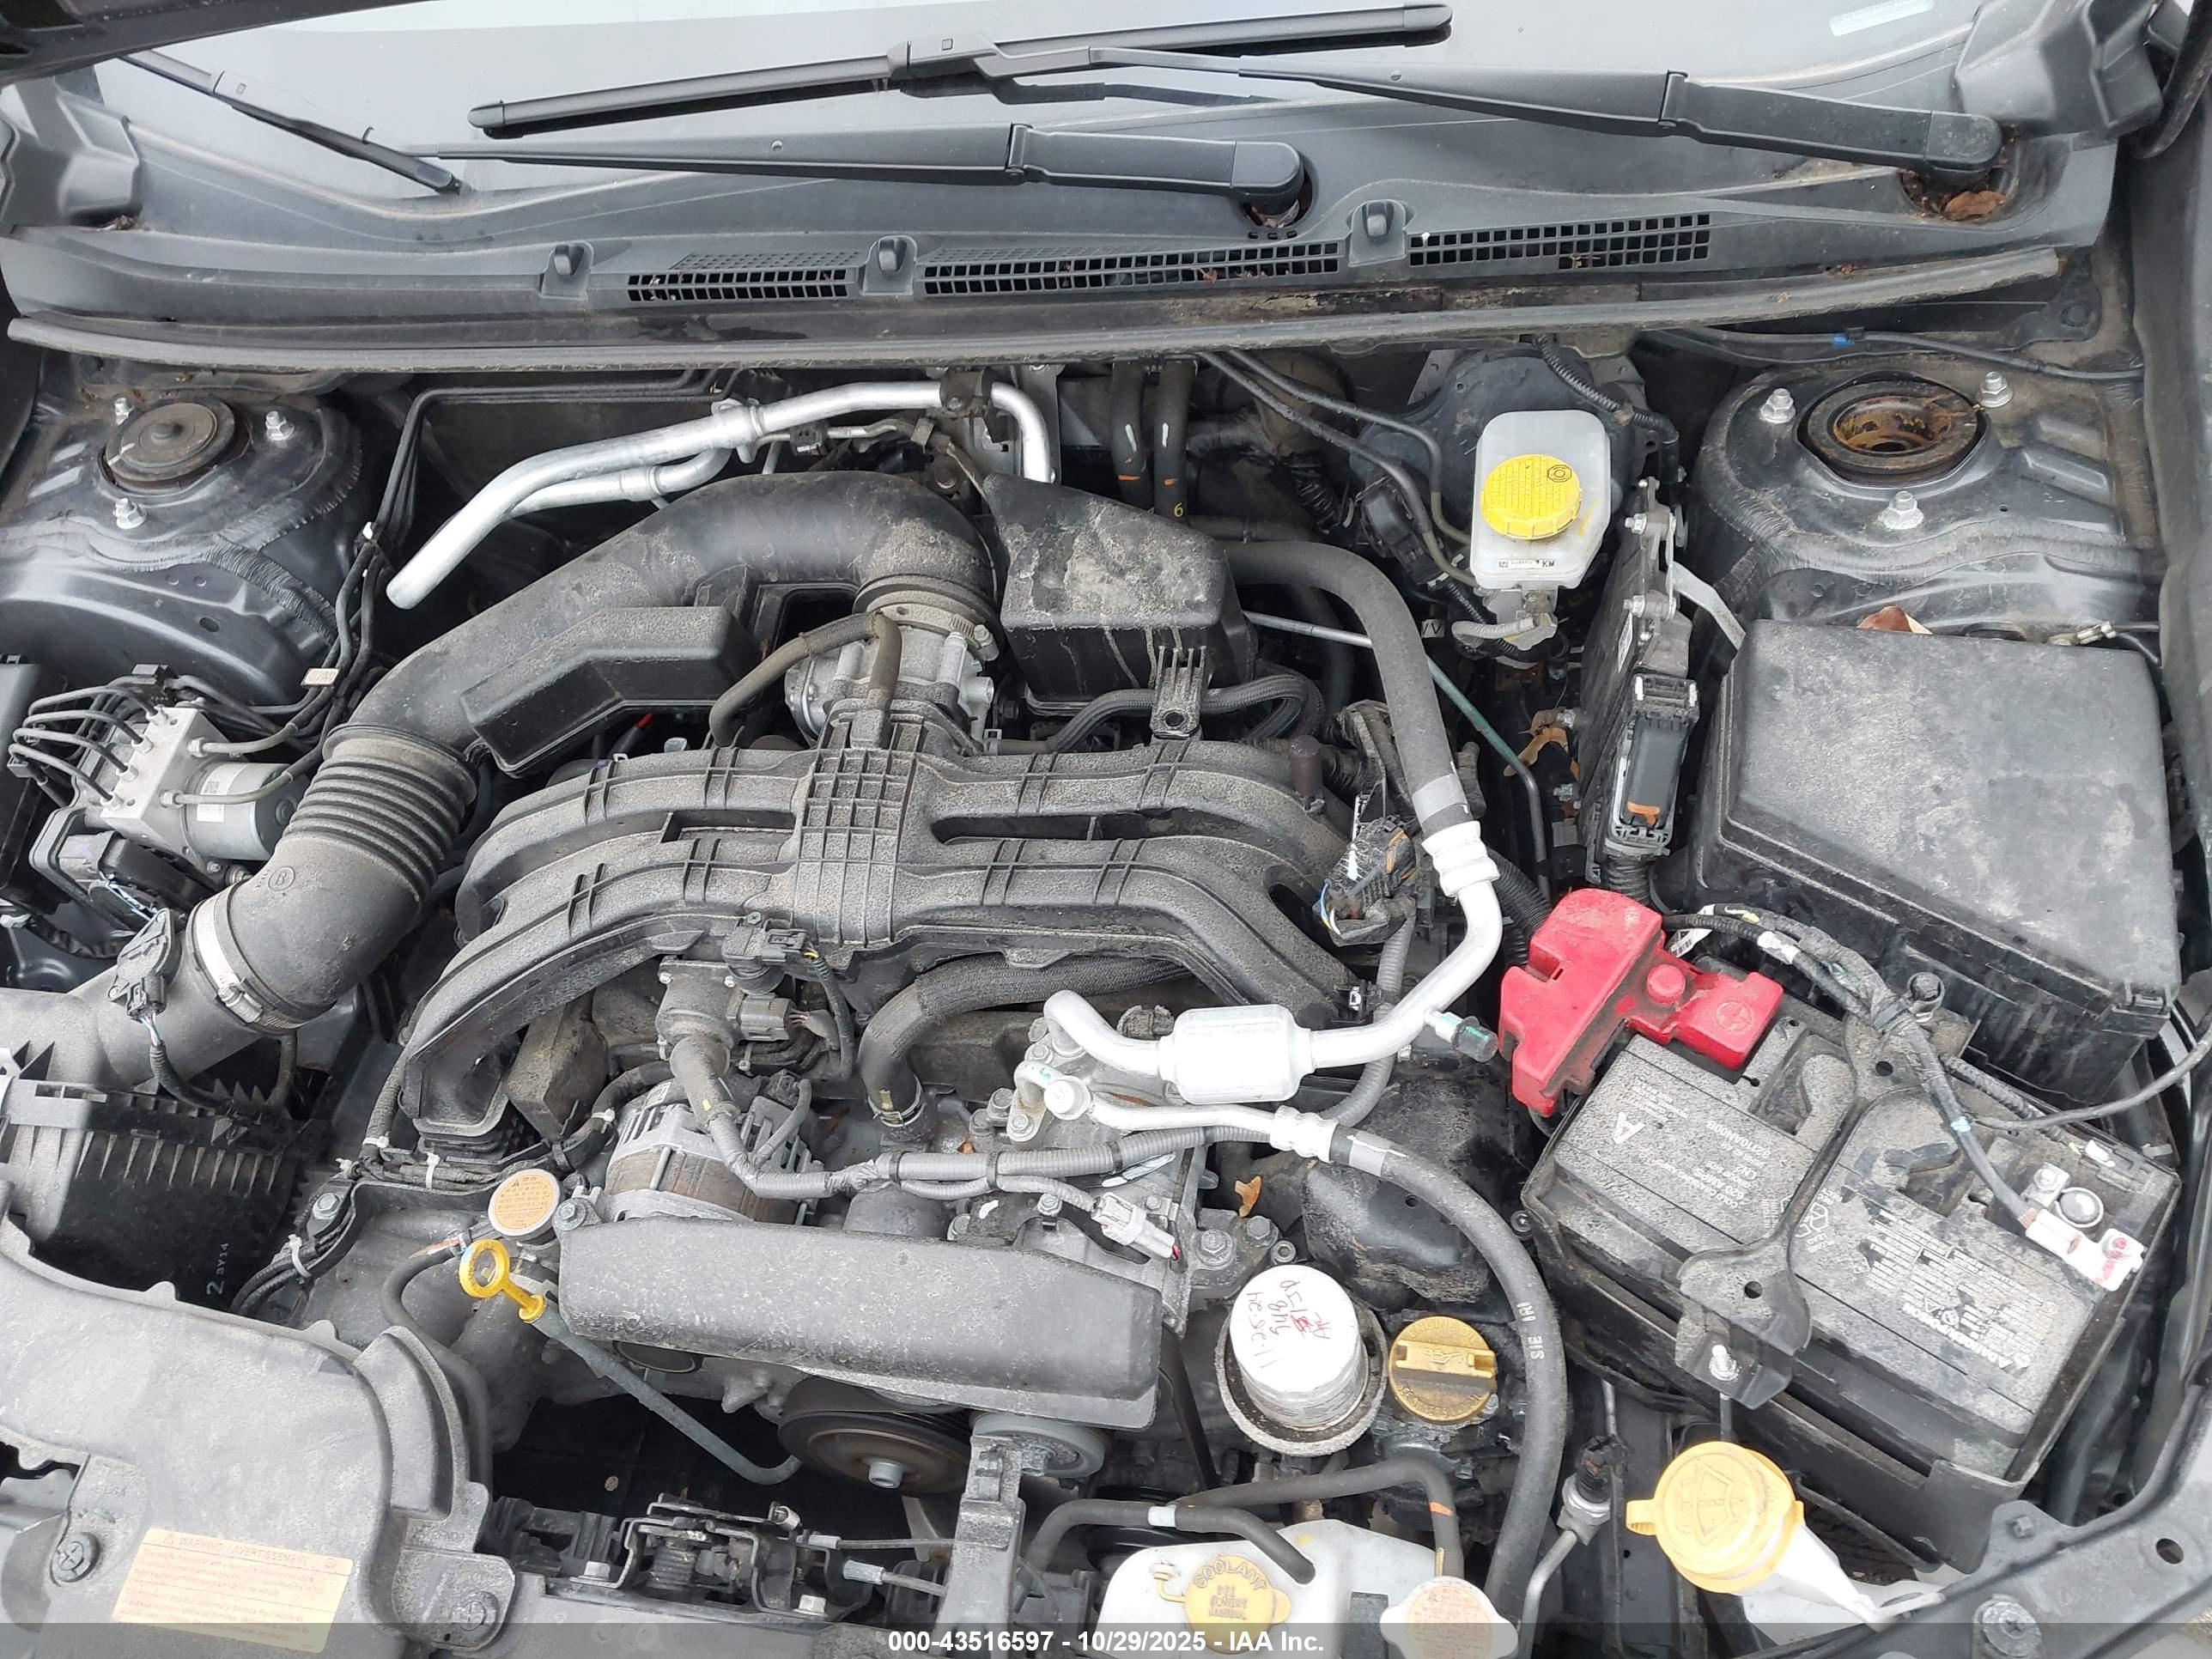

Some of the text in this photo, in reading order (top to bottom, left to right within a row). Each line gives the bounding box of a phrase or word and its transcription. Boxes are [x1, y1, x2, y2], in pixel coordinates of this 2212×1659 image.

[1173, 501, 1183, 517] 6
[1735, 1164, 1758, 1180] LN2
[1694, 1169, 1745, 1200] 620 AMPS
[1716, 1192, 1739, 1209] COLD
[206, 1281, 225, 1295] 2
[1407, 1319, 1481, 1346] ENGINE OIL
[1194, 1559, 1267, 1590] COOLANT
